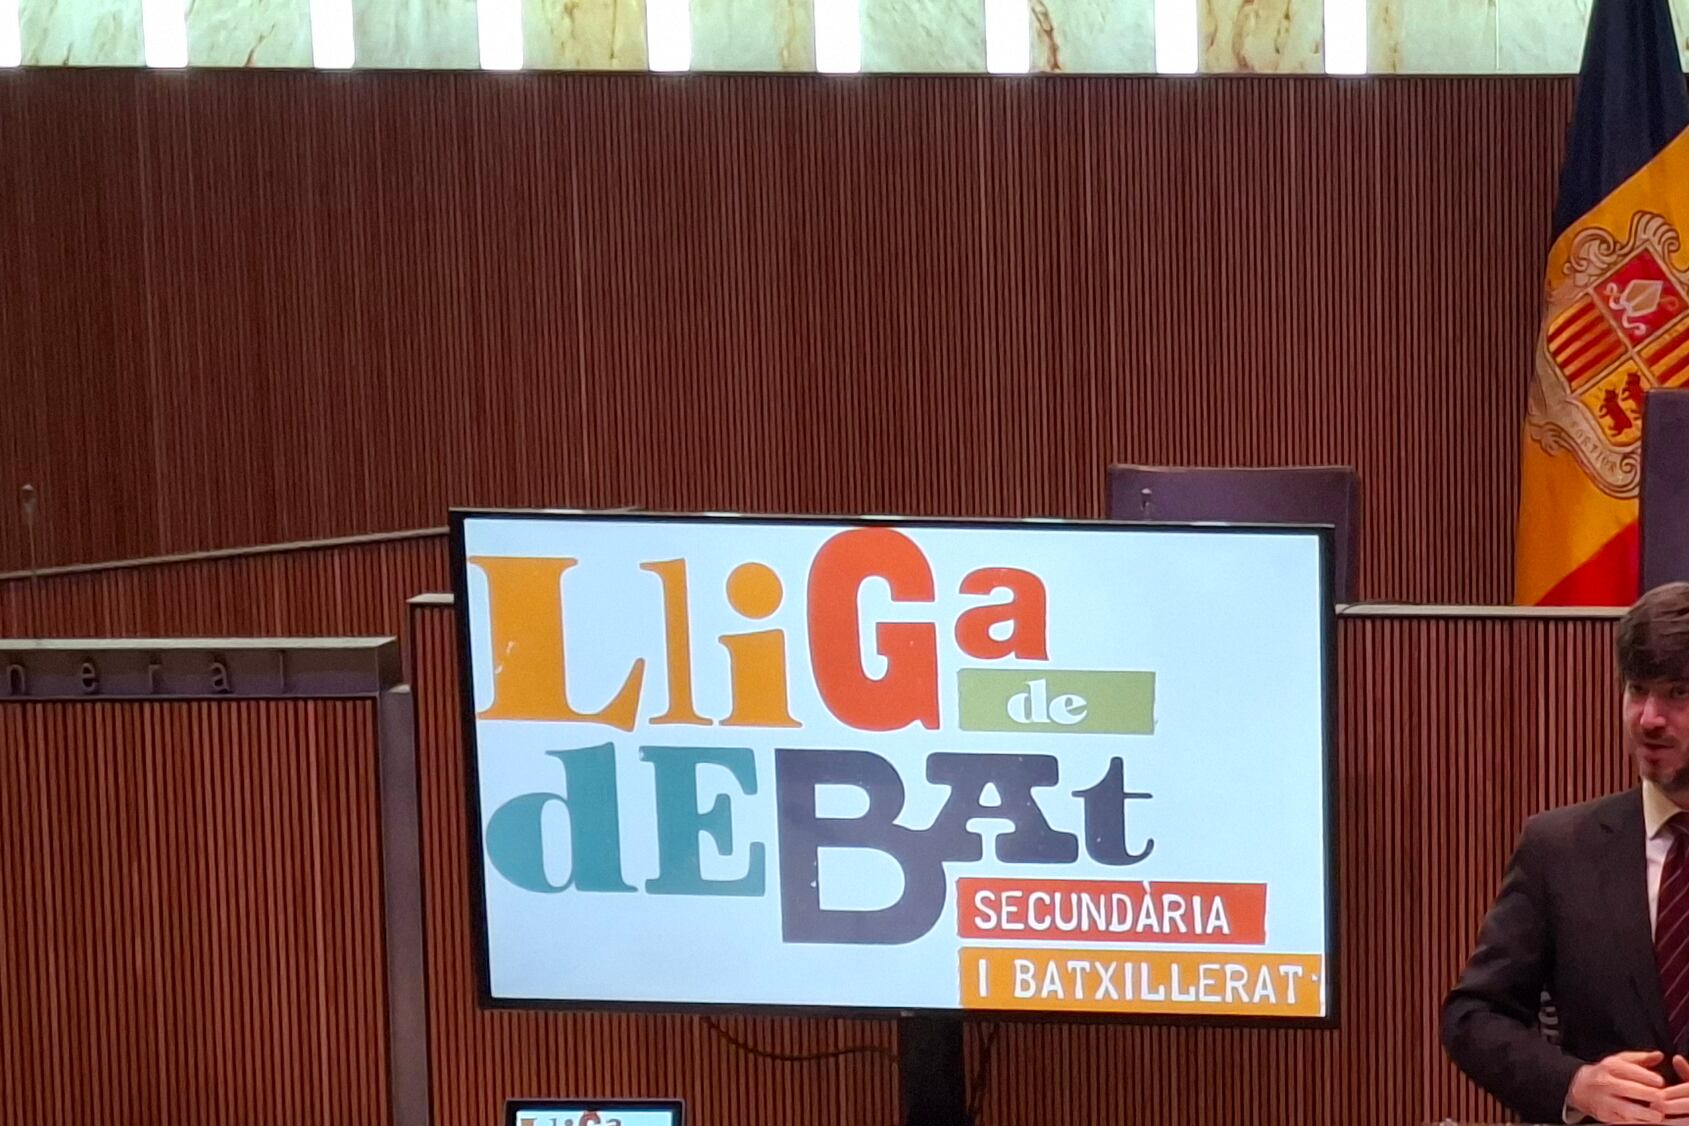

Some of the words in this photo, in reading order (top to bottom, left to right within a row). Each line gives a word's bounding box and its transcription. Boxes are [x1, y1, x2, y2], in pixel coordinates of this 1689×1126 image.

[1006, 679, 1089, 725] de
[972, 884, 1231, 936] SECUNDÀRIA
[978, 959, 990, 998] I
[1014, 959, 1301, 1006] BATXILLERAT
